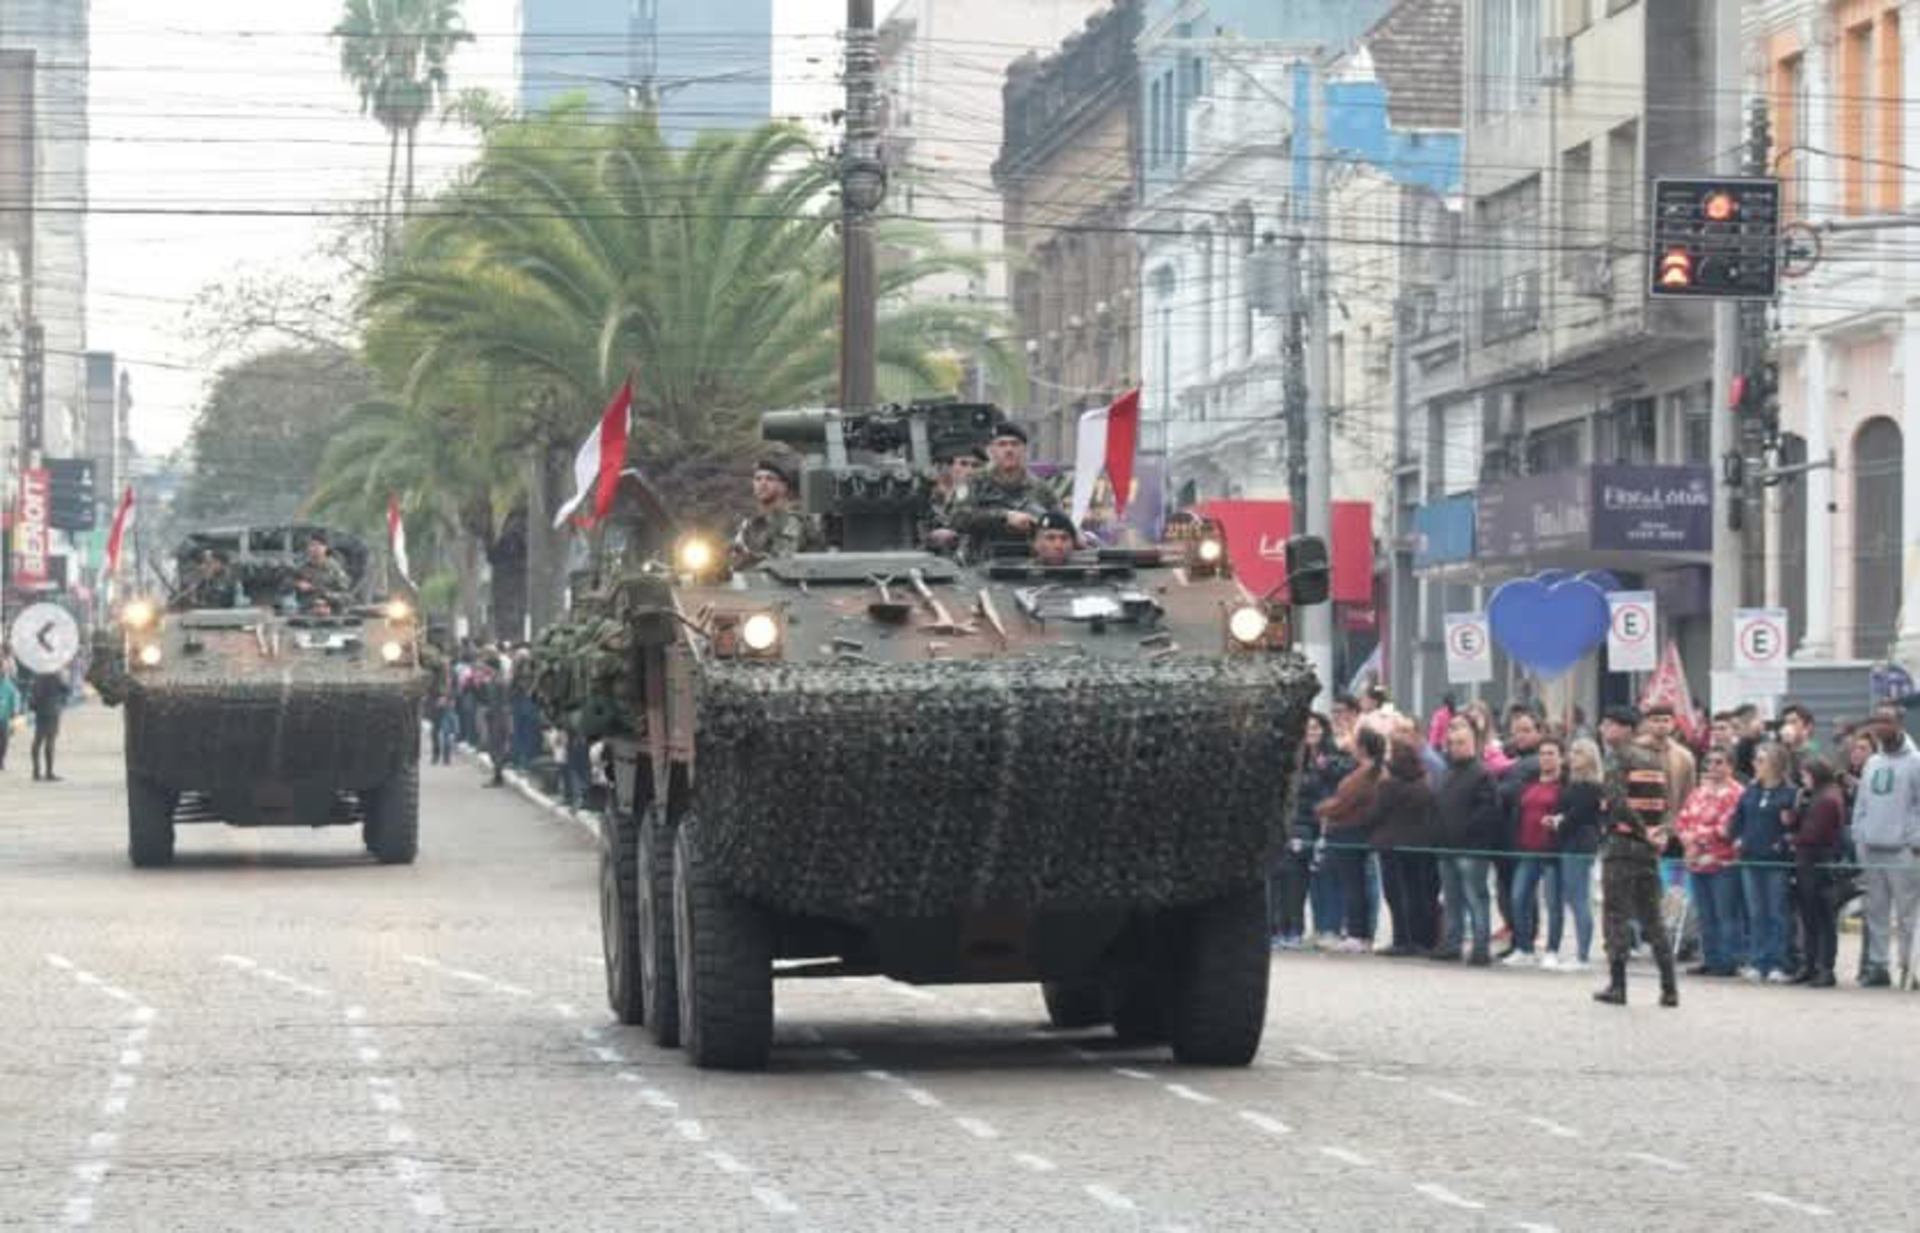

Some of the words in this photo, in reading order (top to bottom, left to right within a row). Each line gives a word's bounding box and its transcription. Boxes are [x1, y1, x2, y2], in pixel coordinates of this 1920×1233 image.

[1623, 612, 1639, 635] E
[1460, 631, 1474, 651] E
[1752, 629, 1768, 653] E
